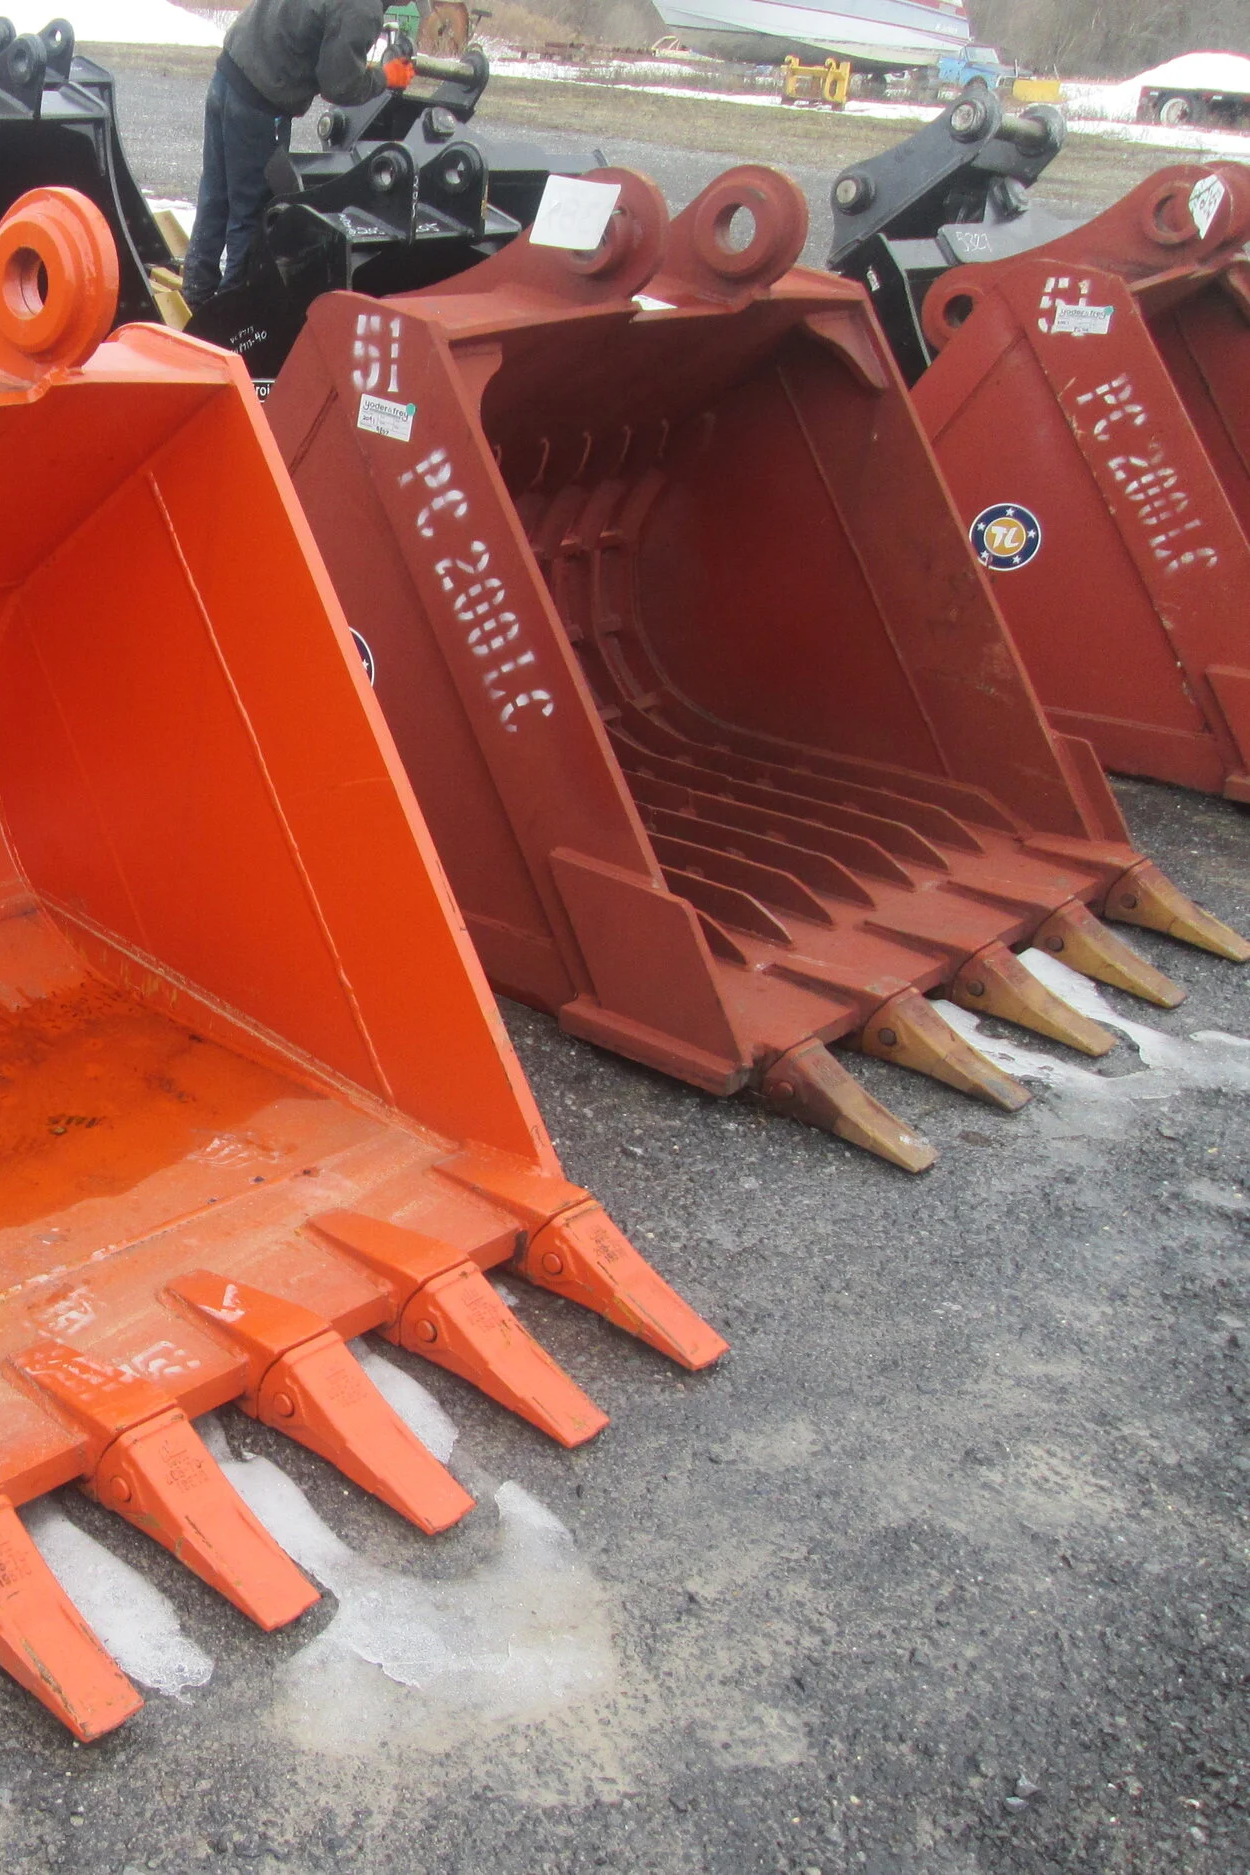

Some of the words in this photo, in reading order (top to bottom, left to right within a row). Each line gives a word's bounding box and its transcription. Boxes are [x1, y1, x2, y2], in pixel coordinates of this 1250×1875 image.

[352, 314, 401, 393] 51
[1075, 373, 1149, 442] PC
[398, 448, 470, 538] PC
